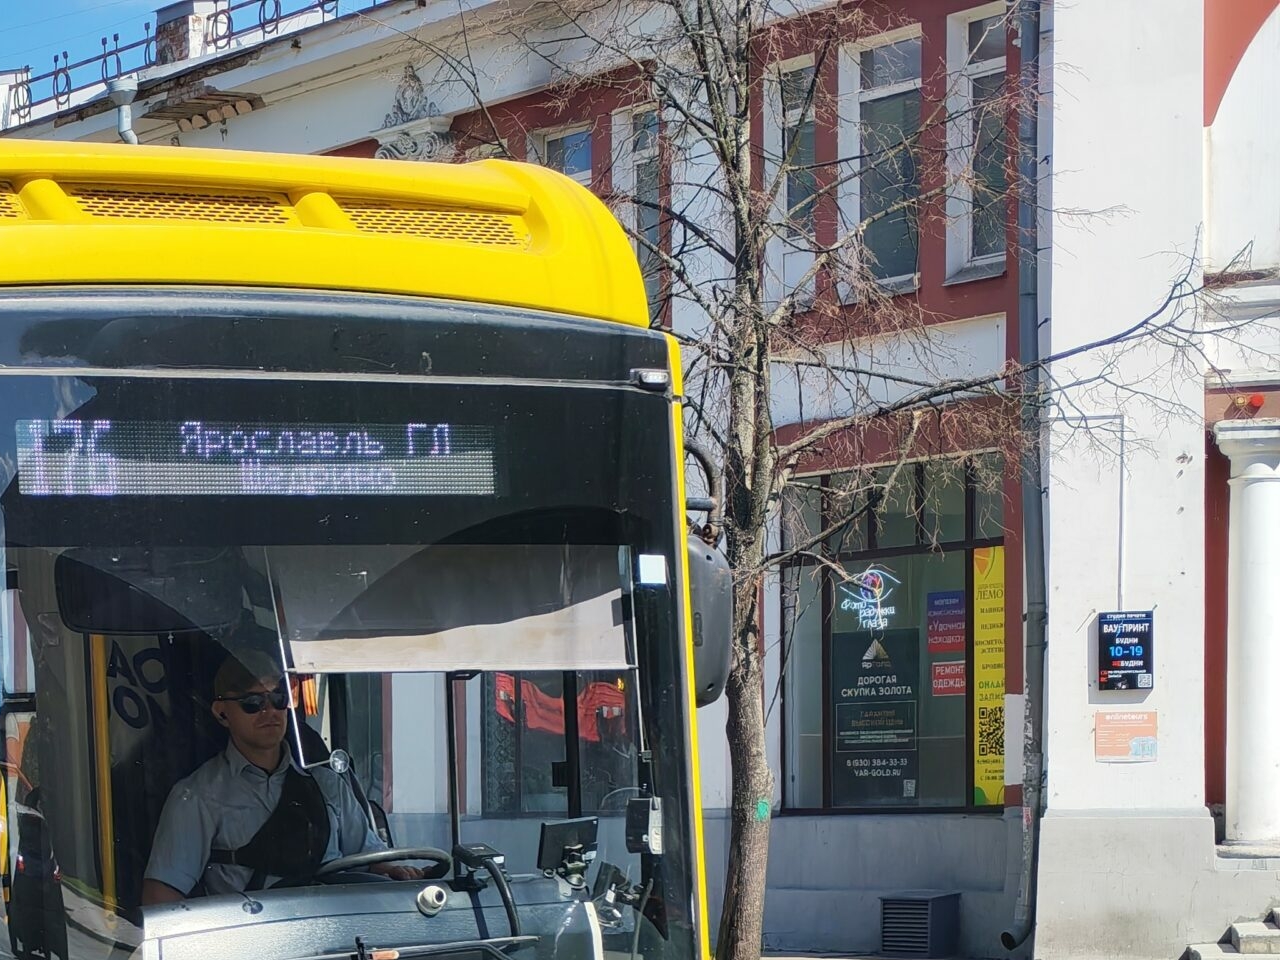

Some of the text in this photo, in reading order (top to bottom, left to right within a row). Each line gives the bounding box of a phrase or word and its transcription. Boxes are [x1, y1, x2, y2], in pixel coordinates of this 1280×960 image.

[28, 420, 118, 495] 176
[181, 420, 385, 459] Ярославль
[841, 598, 867, 611] Фото
[1103, 622, 1150, 633] ВАУ ПРИНТ
[1115, 637, 1139, 645] БУДНИ
[935, 665, 965, 676] РЕМОНТ
[857, 674, 897, 686] ДОРОГАЯ
[841, 685, 913, 698] СКУПКА ЗОЛОТА
[854, 768, 902, 778] YAR-GOLD.RU
